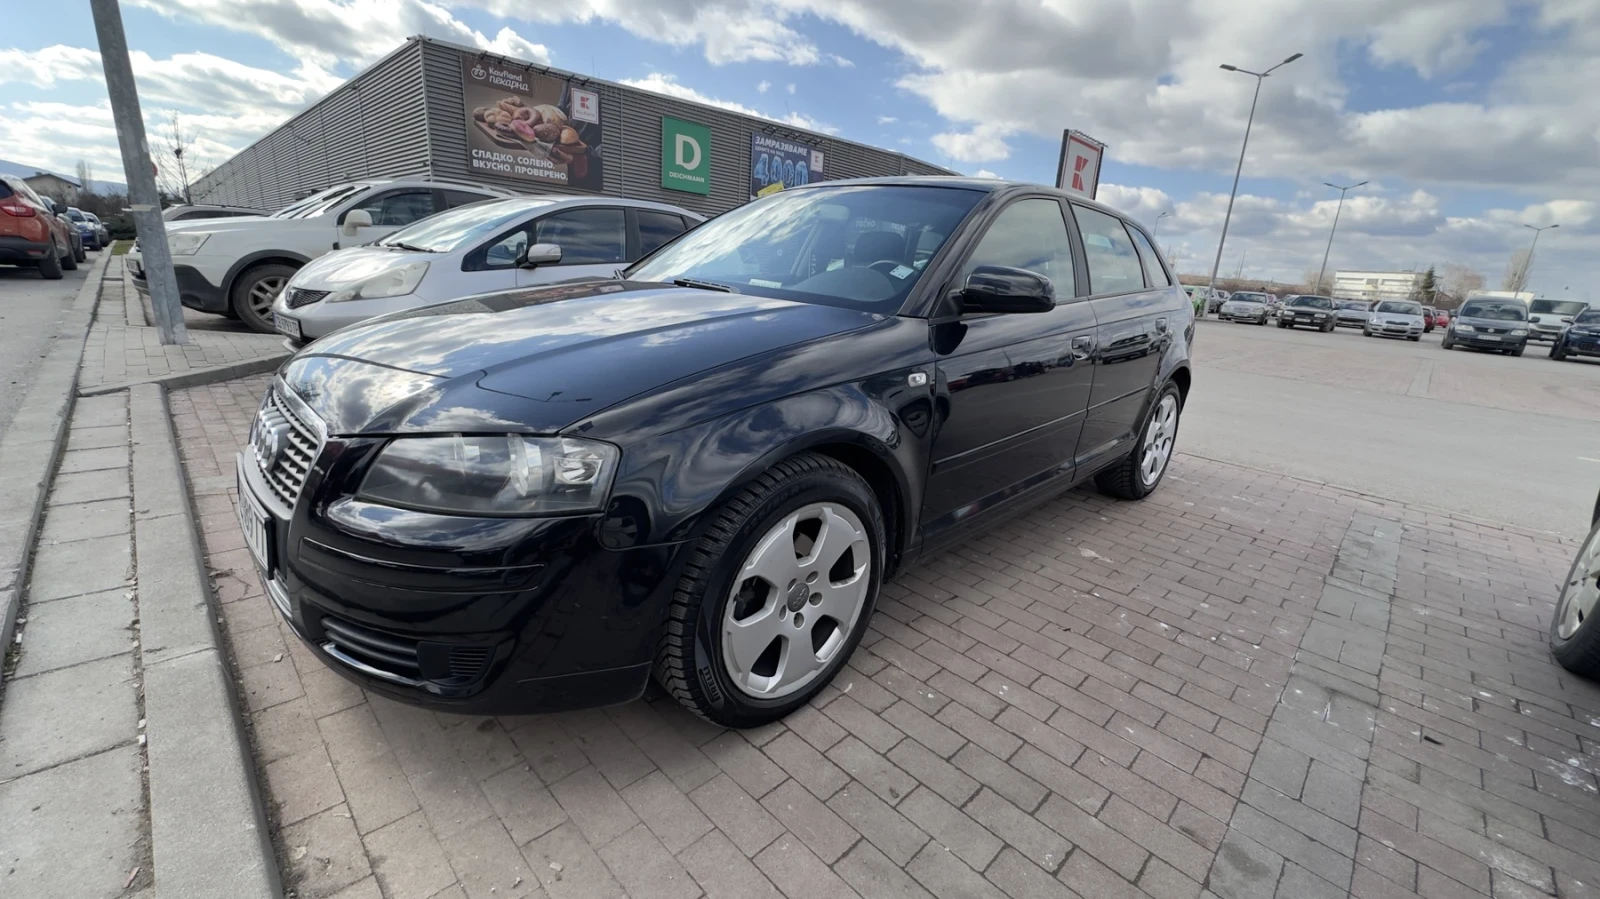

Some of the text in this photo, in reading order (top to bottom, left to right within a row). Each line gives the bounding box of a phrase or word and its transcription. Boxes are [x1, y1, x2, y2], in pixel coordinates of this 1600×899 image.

[488, 66, 523, 82] Kaufland
[489, 75, 530, 92] пекарна
[675, 133, 702, 171] D
[755, 136, 808, 156] ЗАМРАЗЯВАМЕ
[471, 148, 556, 170] СЛАДКО. СОЛЕНО.
[472, 158, 568, 181] ВКУСНО. ПРОВЕРЕНО.
[669, 171, 704, 183] DEICHMANN
[753, 153, 809, 188] 4000
[699, 665, 722, 704] PIRELLI
